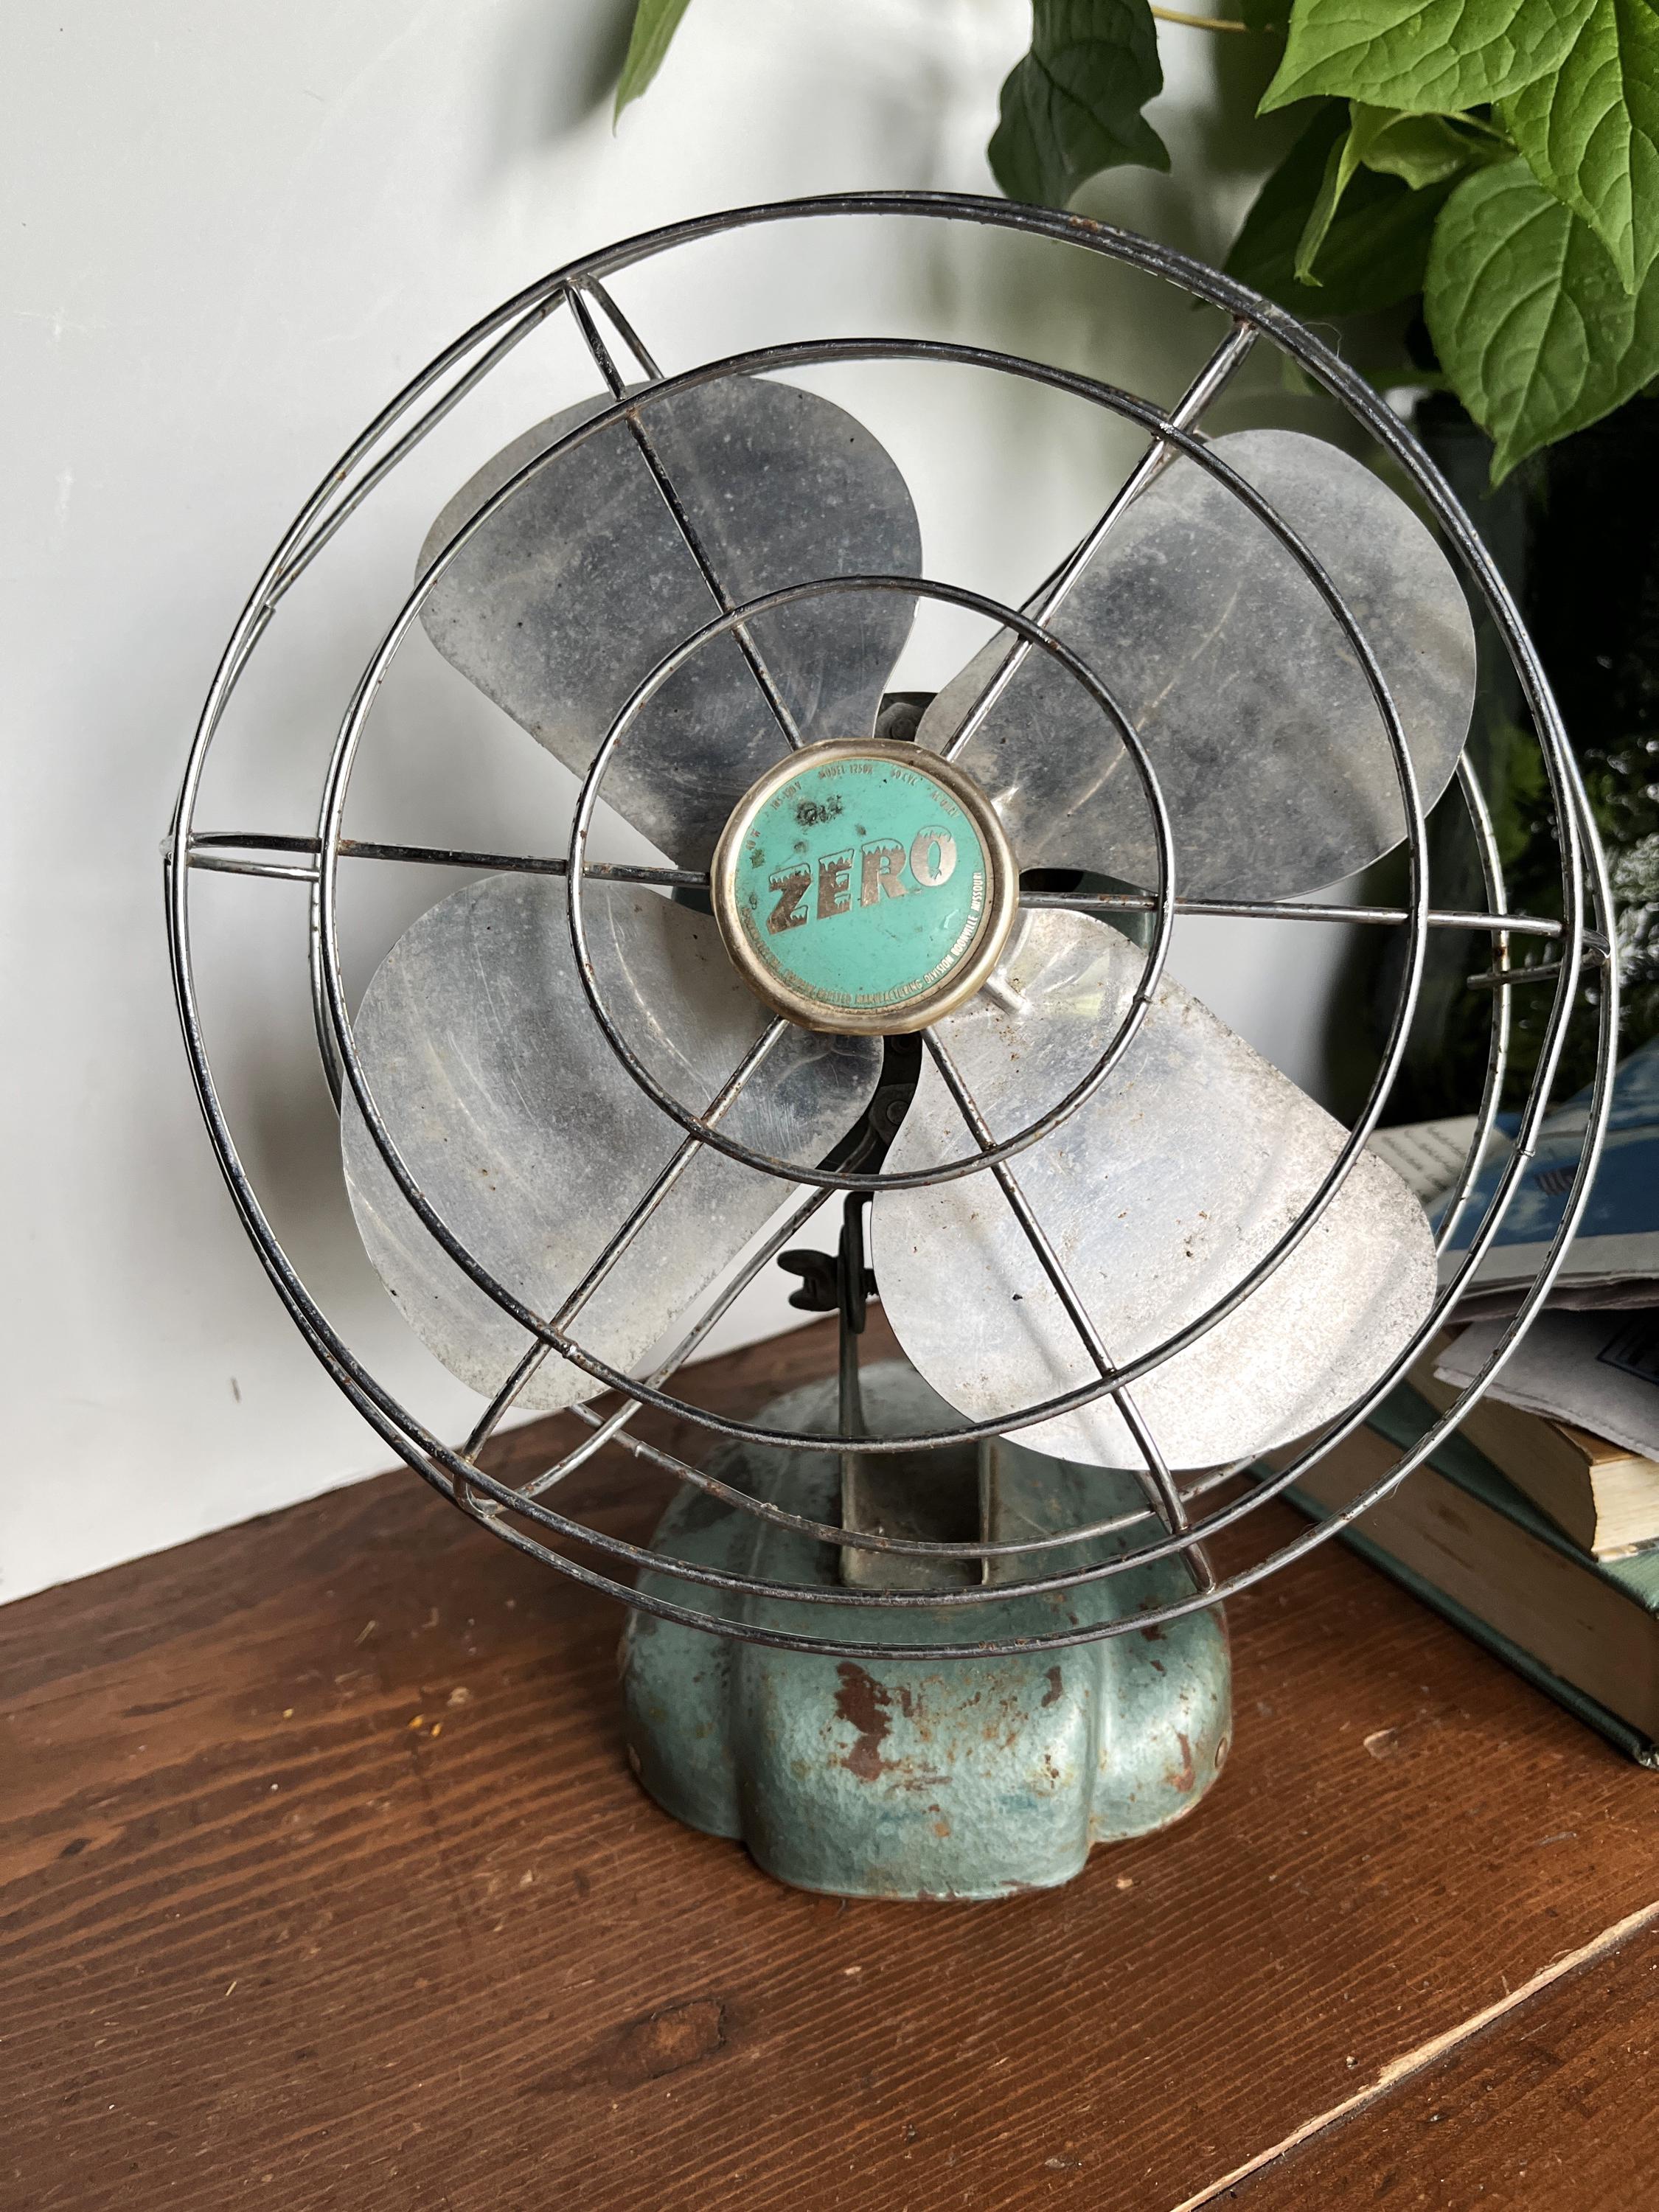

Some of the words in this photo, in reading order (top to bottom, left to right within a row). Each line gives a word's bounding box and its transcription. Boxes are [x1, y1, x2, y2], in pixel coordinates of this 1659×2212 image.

[818, 765, 846, 779] MODEL
[902, 771, 919, 787] CYC
[767, 825, 958, 935] ZERO
[855, 978, 923, 1004] MANUFACTURING
[923, 955, 955, 984] DIVISION
[950, 914, 978, 956] BOONVILLE
[970, 872, 983, 912] MISSOURI
